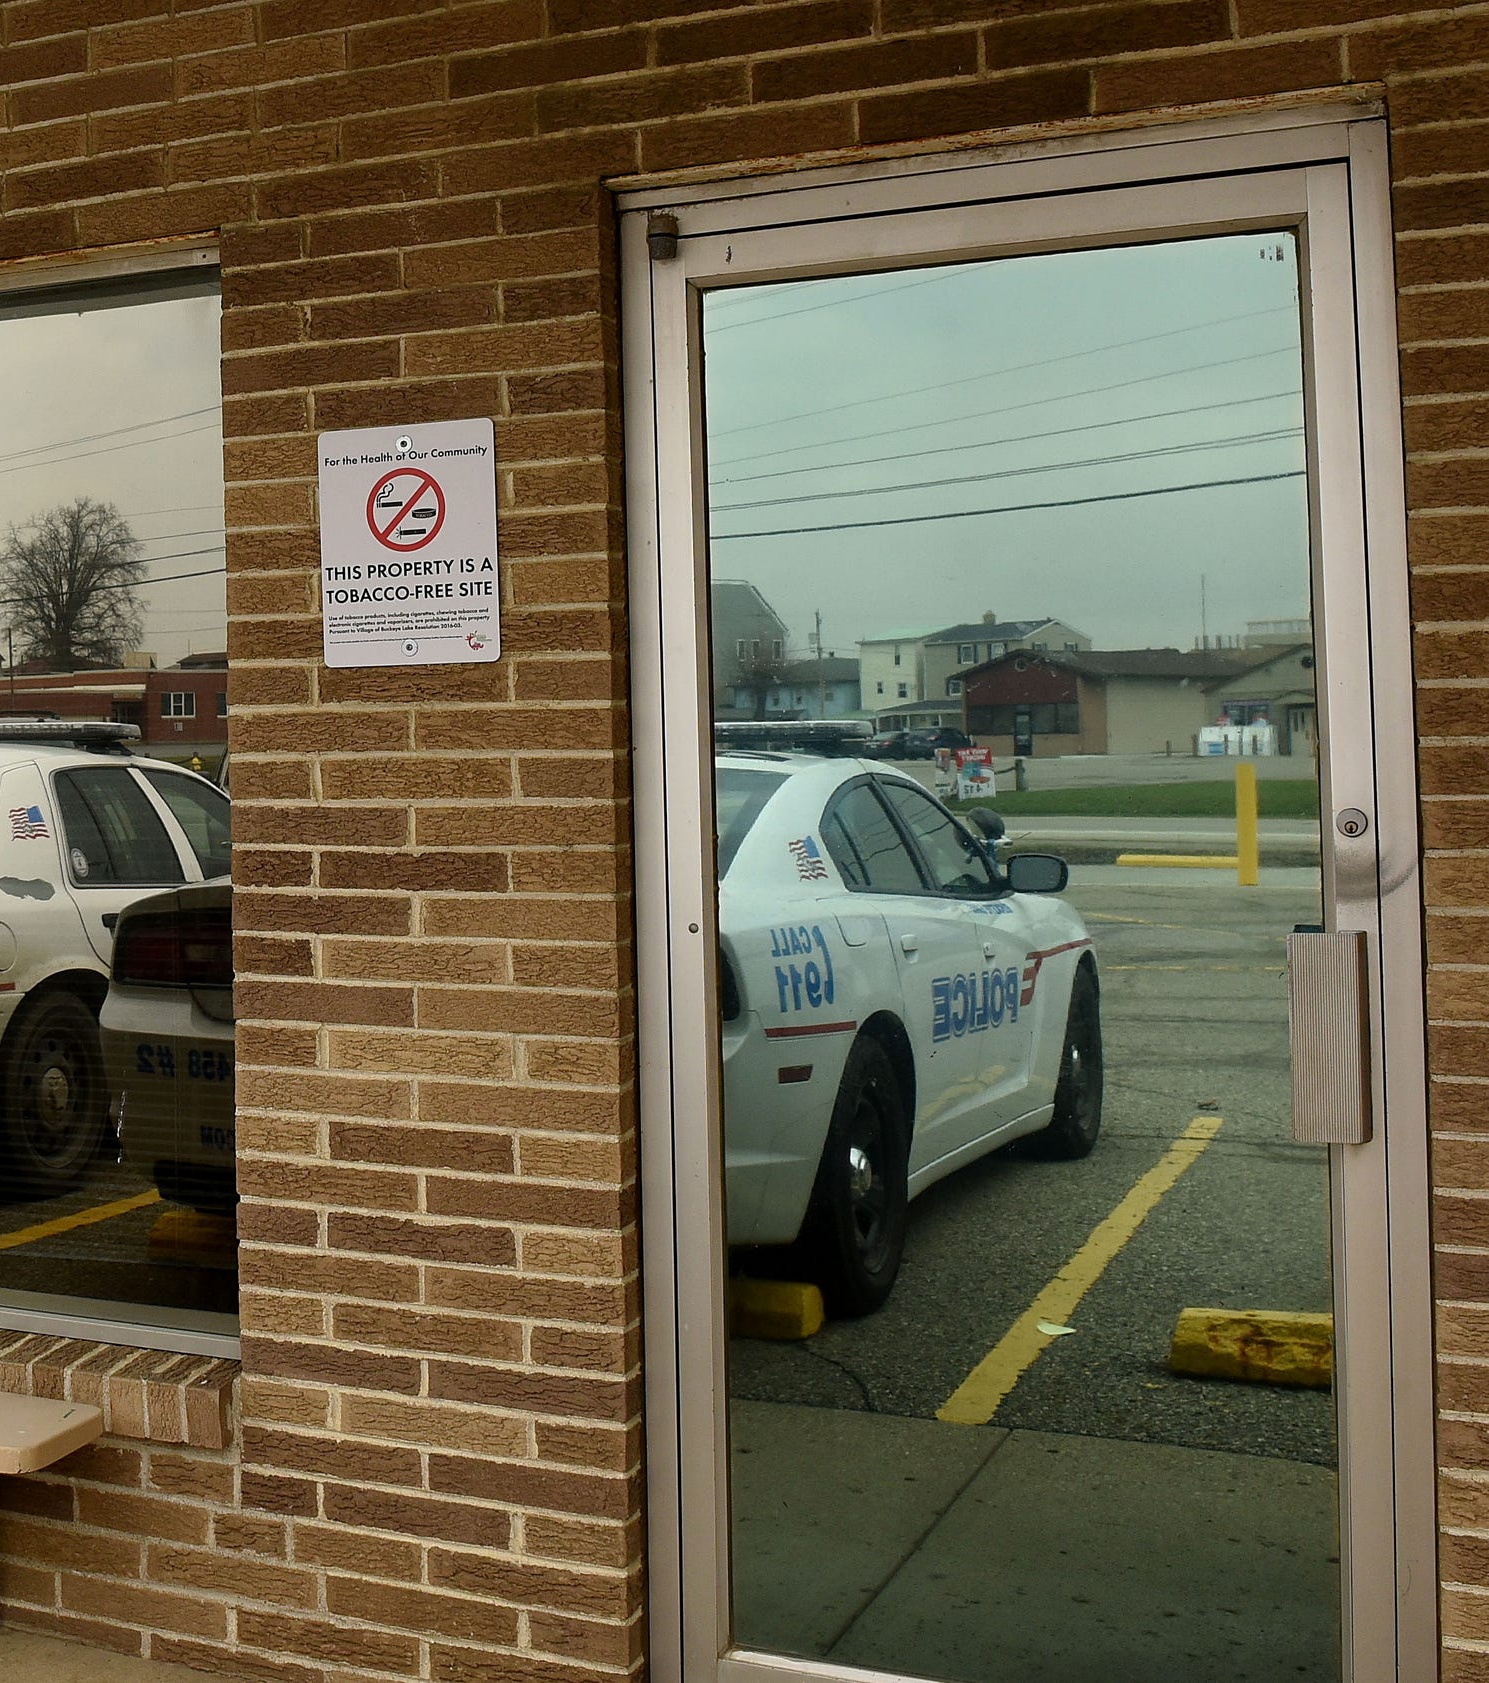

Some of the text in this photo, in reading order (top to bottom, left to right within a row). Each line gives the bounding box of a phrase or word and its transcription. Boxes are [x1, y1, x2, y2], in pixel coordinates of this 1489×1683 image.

[324, 445, 488, 467] For the Health of Our Community
[325, 557, 494, 581] THIS PROPERTY IS A
[325, 580, 493, 604] TOBACCO-FREE SITE
